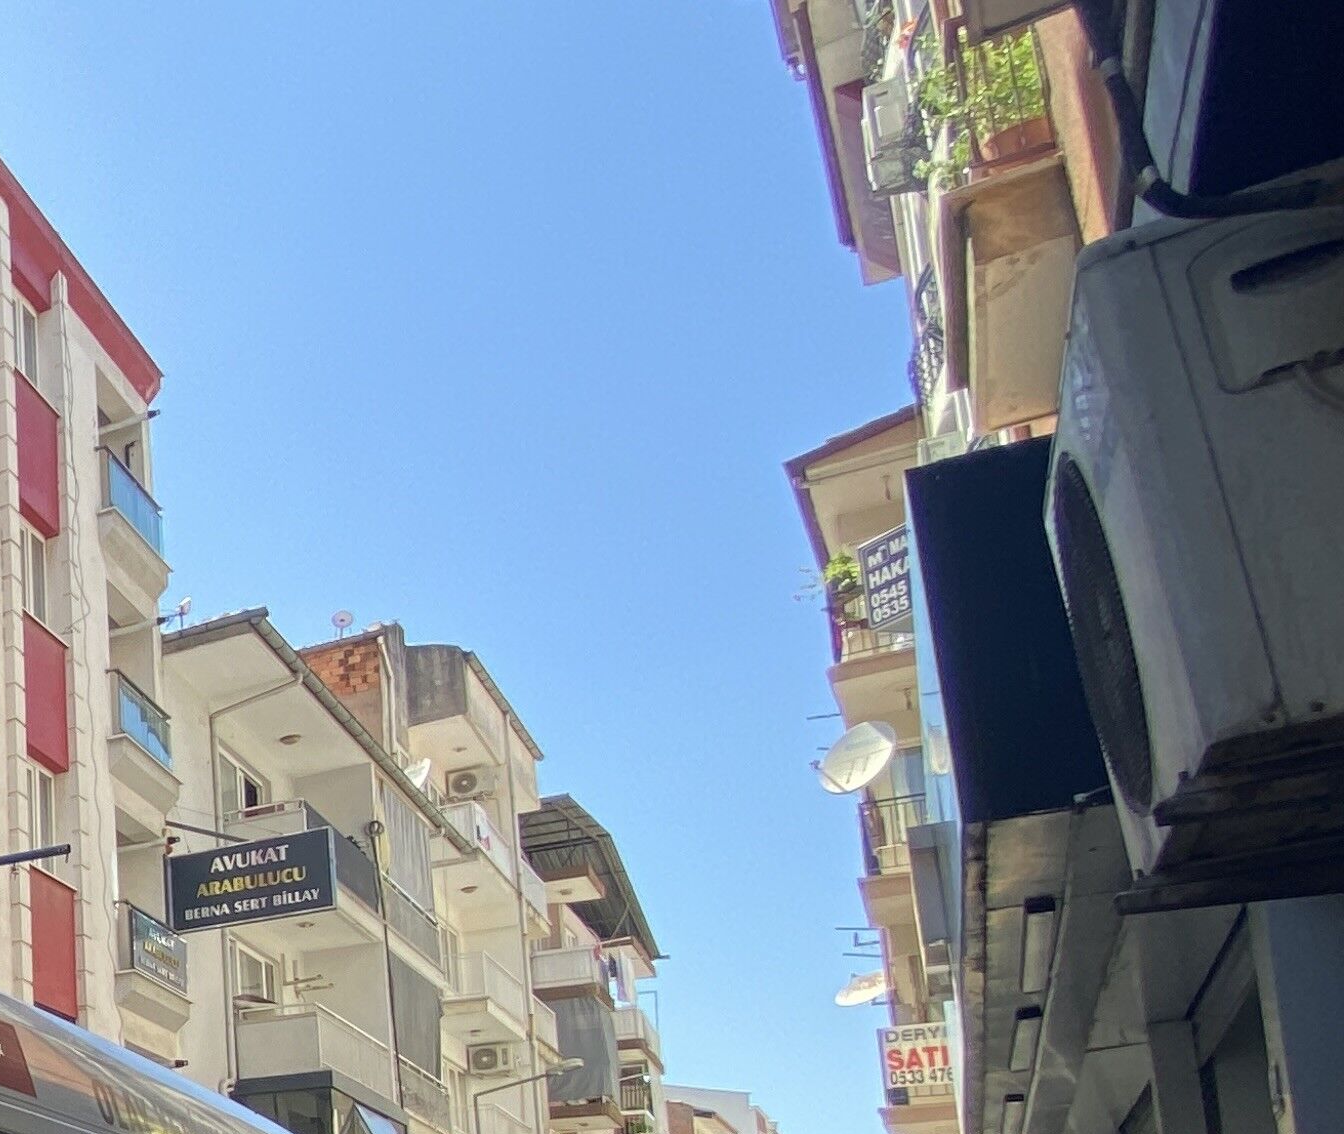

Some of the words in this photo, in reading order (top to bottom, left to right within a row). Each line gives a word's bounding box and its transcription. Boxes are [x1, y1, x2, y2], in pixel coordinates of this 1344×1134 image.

[871, 580, 908, 608] 0545
[210, 844, 289, 874] AVUKAT
[196, 866, 307, 899] ARABULUCU
[184, 902, 230, 921] BERNA
[234, 897, 267, 915] SERT
[272, 888, 321, 906] BİLLAY
[890, 1069, 925, 1085] 0533
